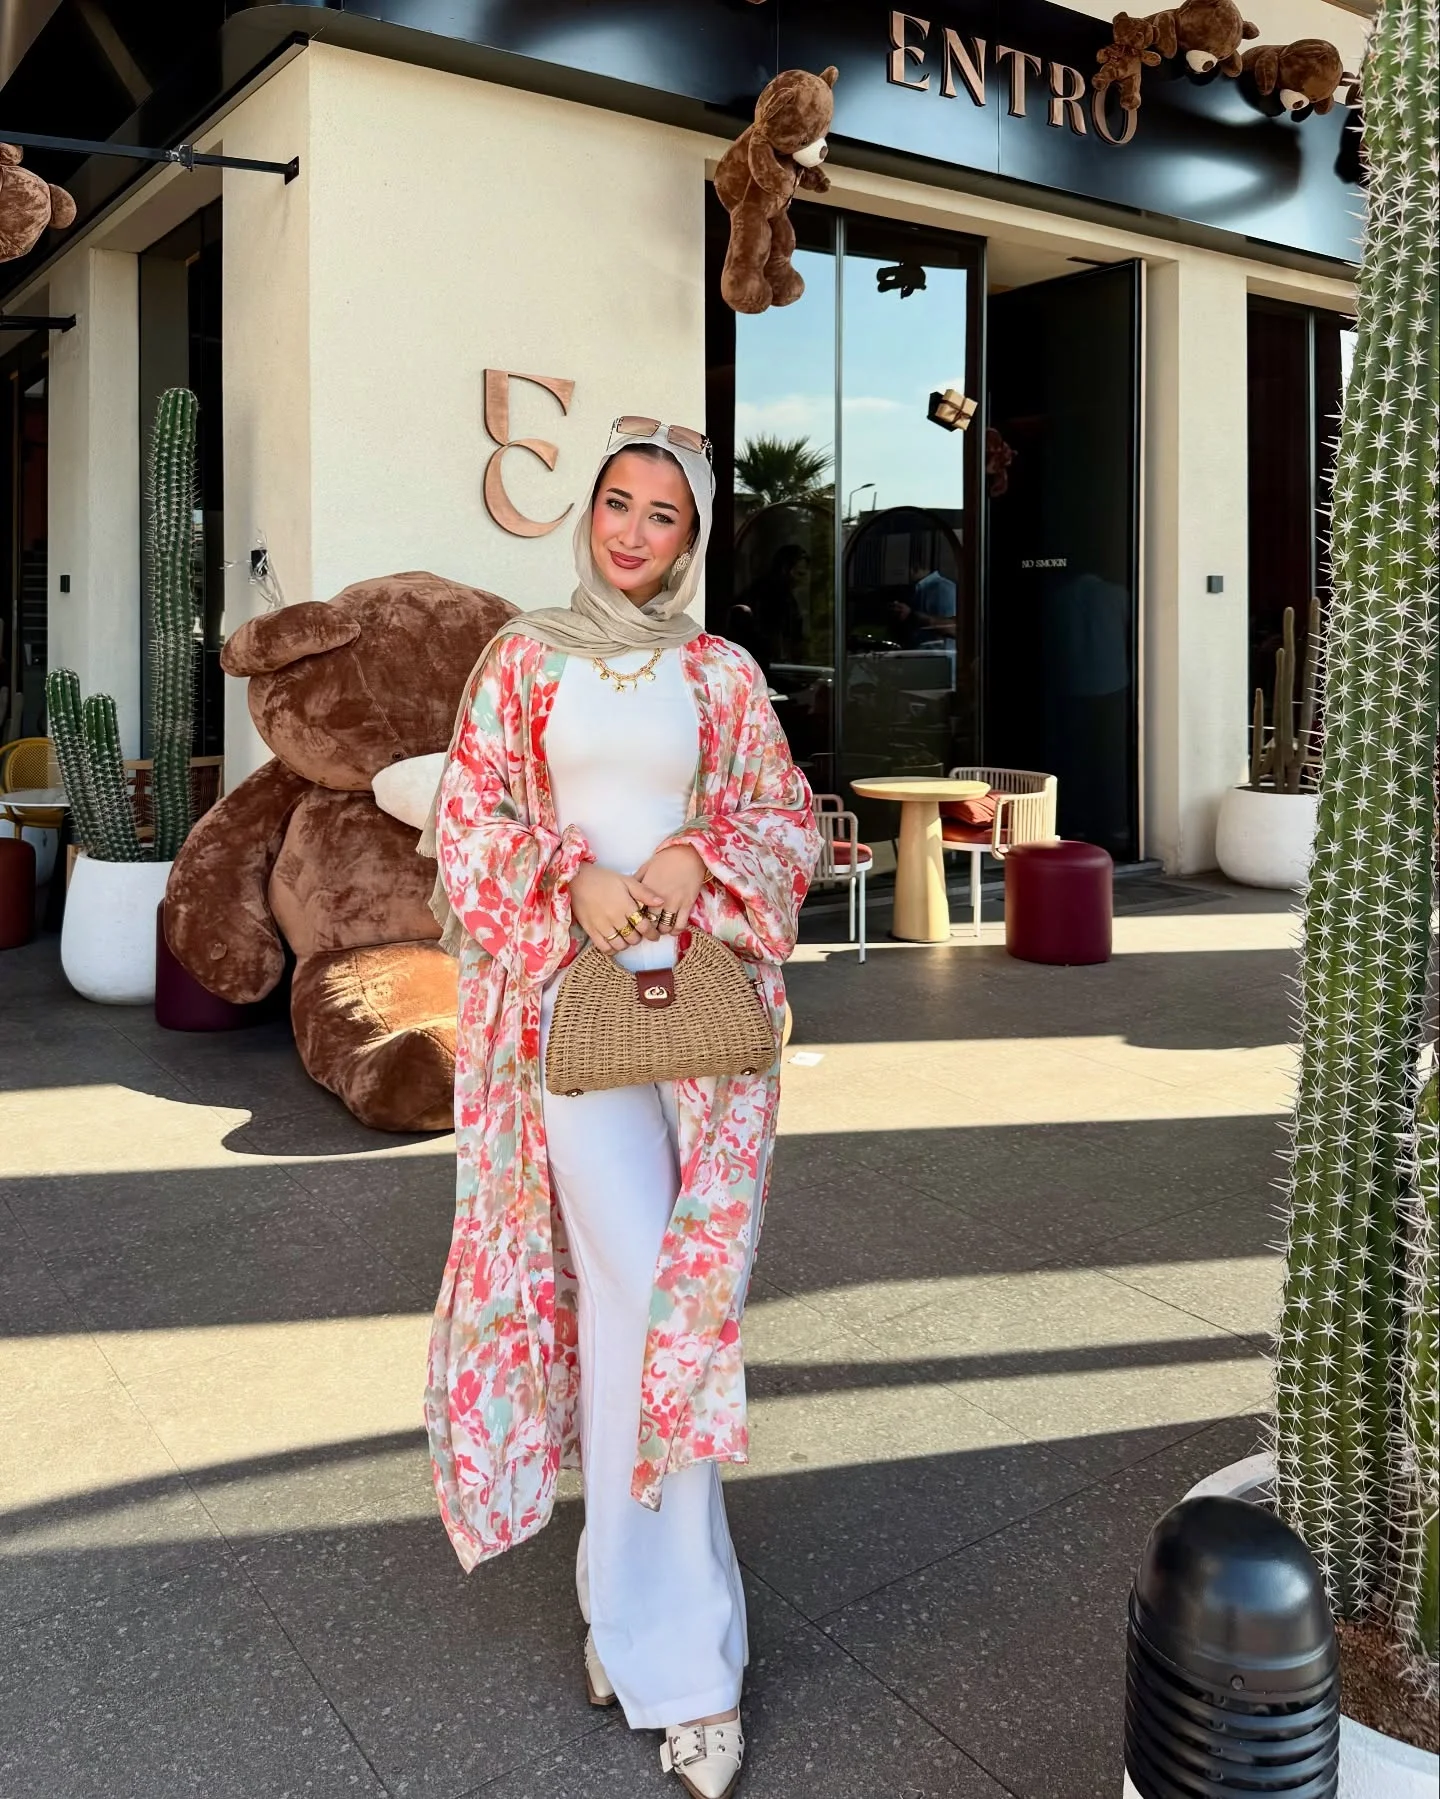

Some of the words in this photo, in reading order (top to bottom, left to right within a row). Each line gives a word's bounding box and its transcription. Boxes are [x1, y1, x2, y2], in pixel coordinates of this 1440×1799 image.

[887, 10, 1138, 145] ENTRO
[483, 368, 576, 539] E
[1021, 559, 1034, 569] NO
